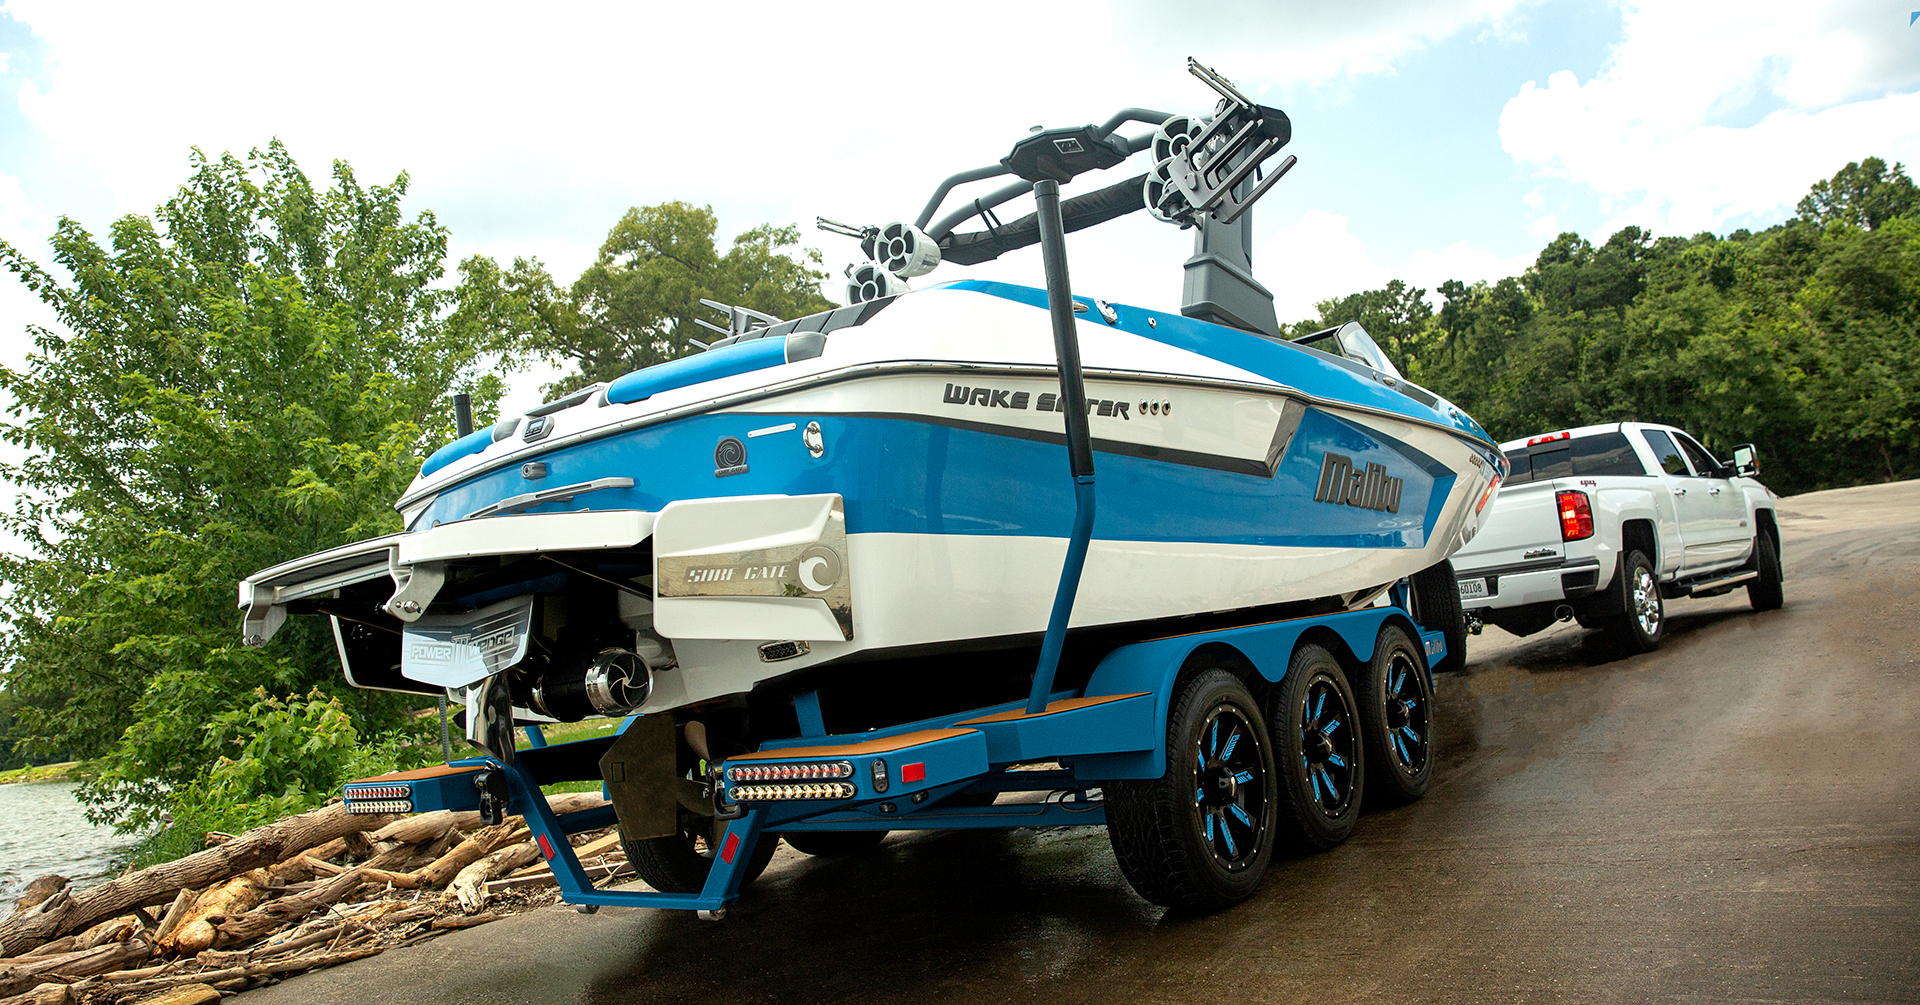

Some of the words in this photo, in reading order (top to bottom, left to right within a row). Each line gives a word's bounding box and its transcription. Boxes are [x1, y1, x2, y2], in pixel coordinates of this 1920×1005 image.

[943, 383, 1030, 410] WAKE
[1313, 451, 1404, 514] Malibu
[687, 566, 740, 583] SURF
[744, 564, 791, 580] GATE
[411, 644, 452, 661] POWER
